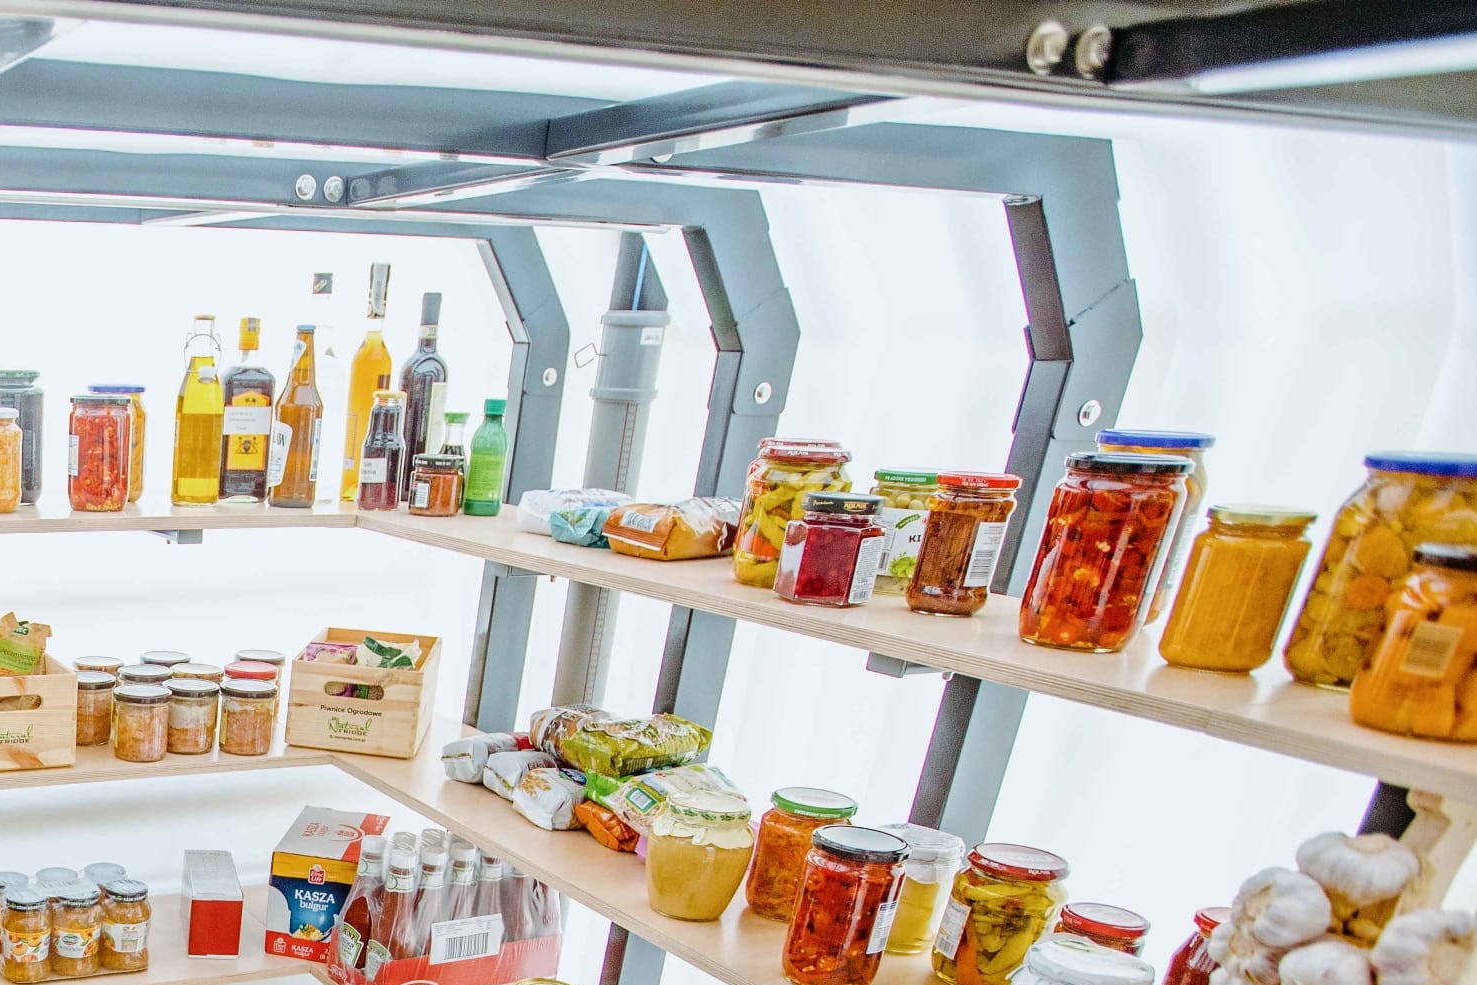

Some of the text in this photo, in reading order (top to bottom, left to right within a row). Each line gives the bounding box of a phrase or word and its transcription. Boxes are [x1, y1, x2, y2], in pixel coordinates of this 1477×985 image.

[320, 704, 382, 717] Piwnice Ogrodowe
[294, 888, 335, 904] KASZA
[299, 899, 329, 912] bulgur
